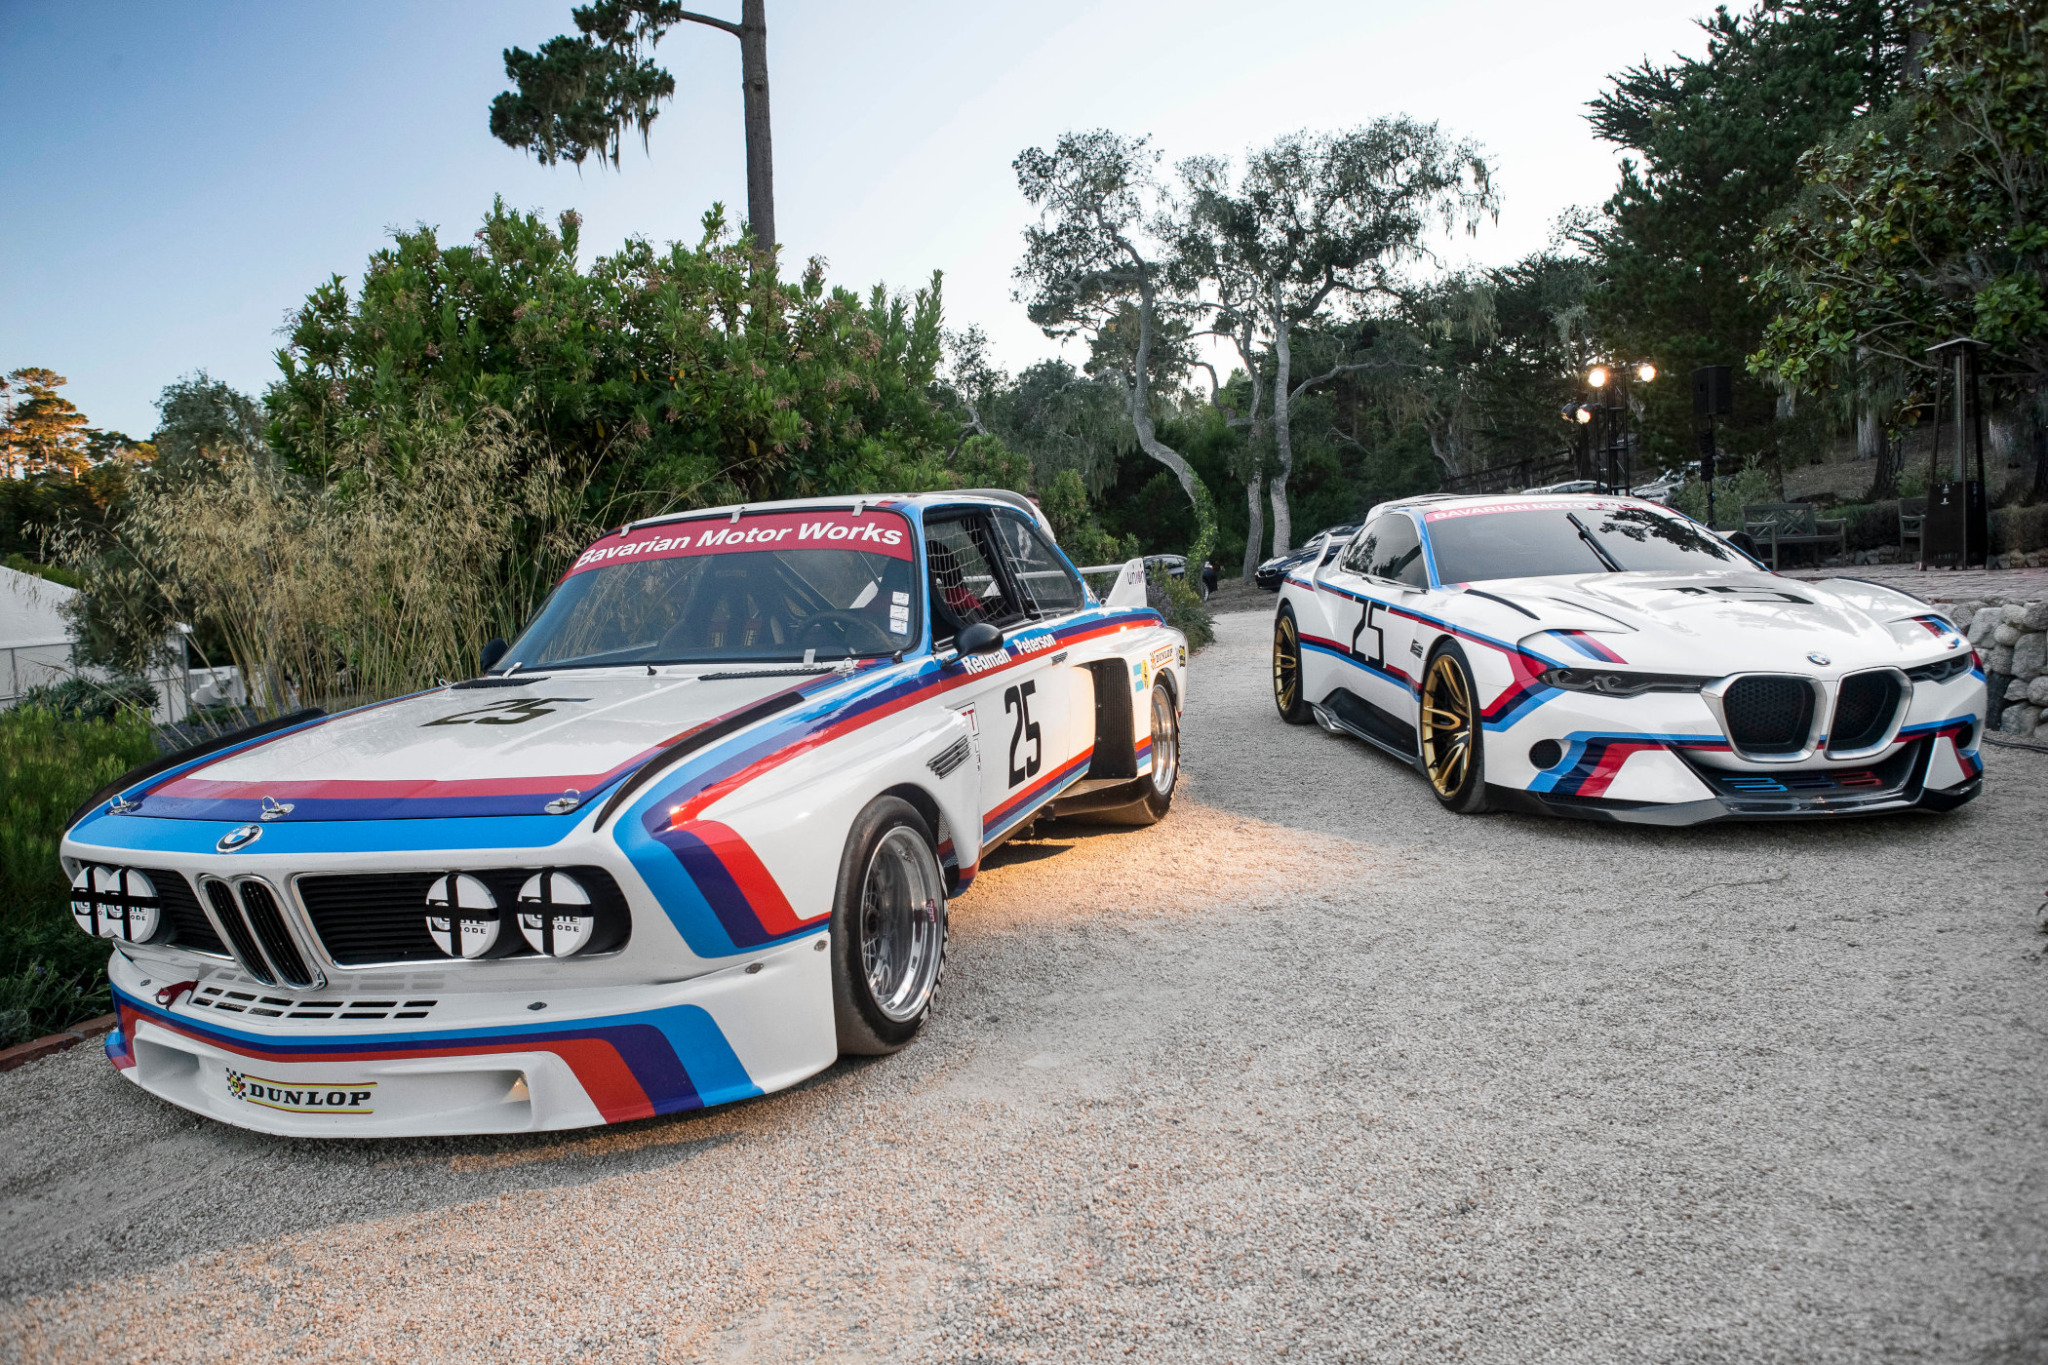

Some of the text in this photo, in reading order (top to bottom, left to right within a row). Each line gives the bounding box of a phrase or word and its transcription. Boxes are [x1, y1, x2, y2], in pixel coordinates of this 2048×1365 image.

[1433, 504, 1529, 519] BAVARIAN
[573, 522, 903, 570] Bavarian Motor Works
[1352, 596, 1385, 669] 25
[960, 633, 1057, 675] Redman Peterson
[417, 697, 595, 727] 25
[1004, 679, 1042, 789] 25
[249, 1083, 372, 1106] DUNLOP
